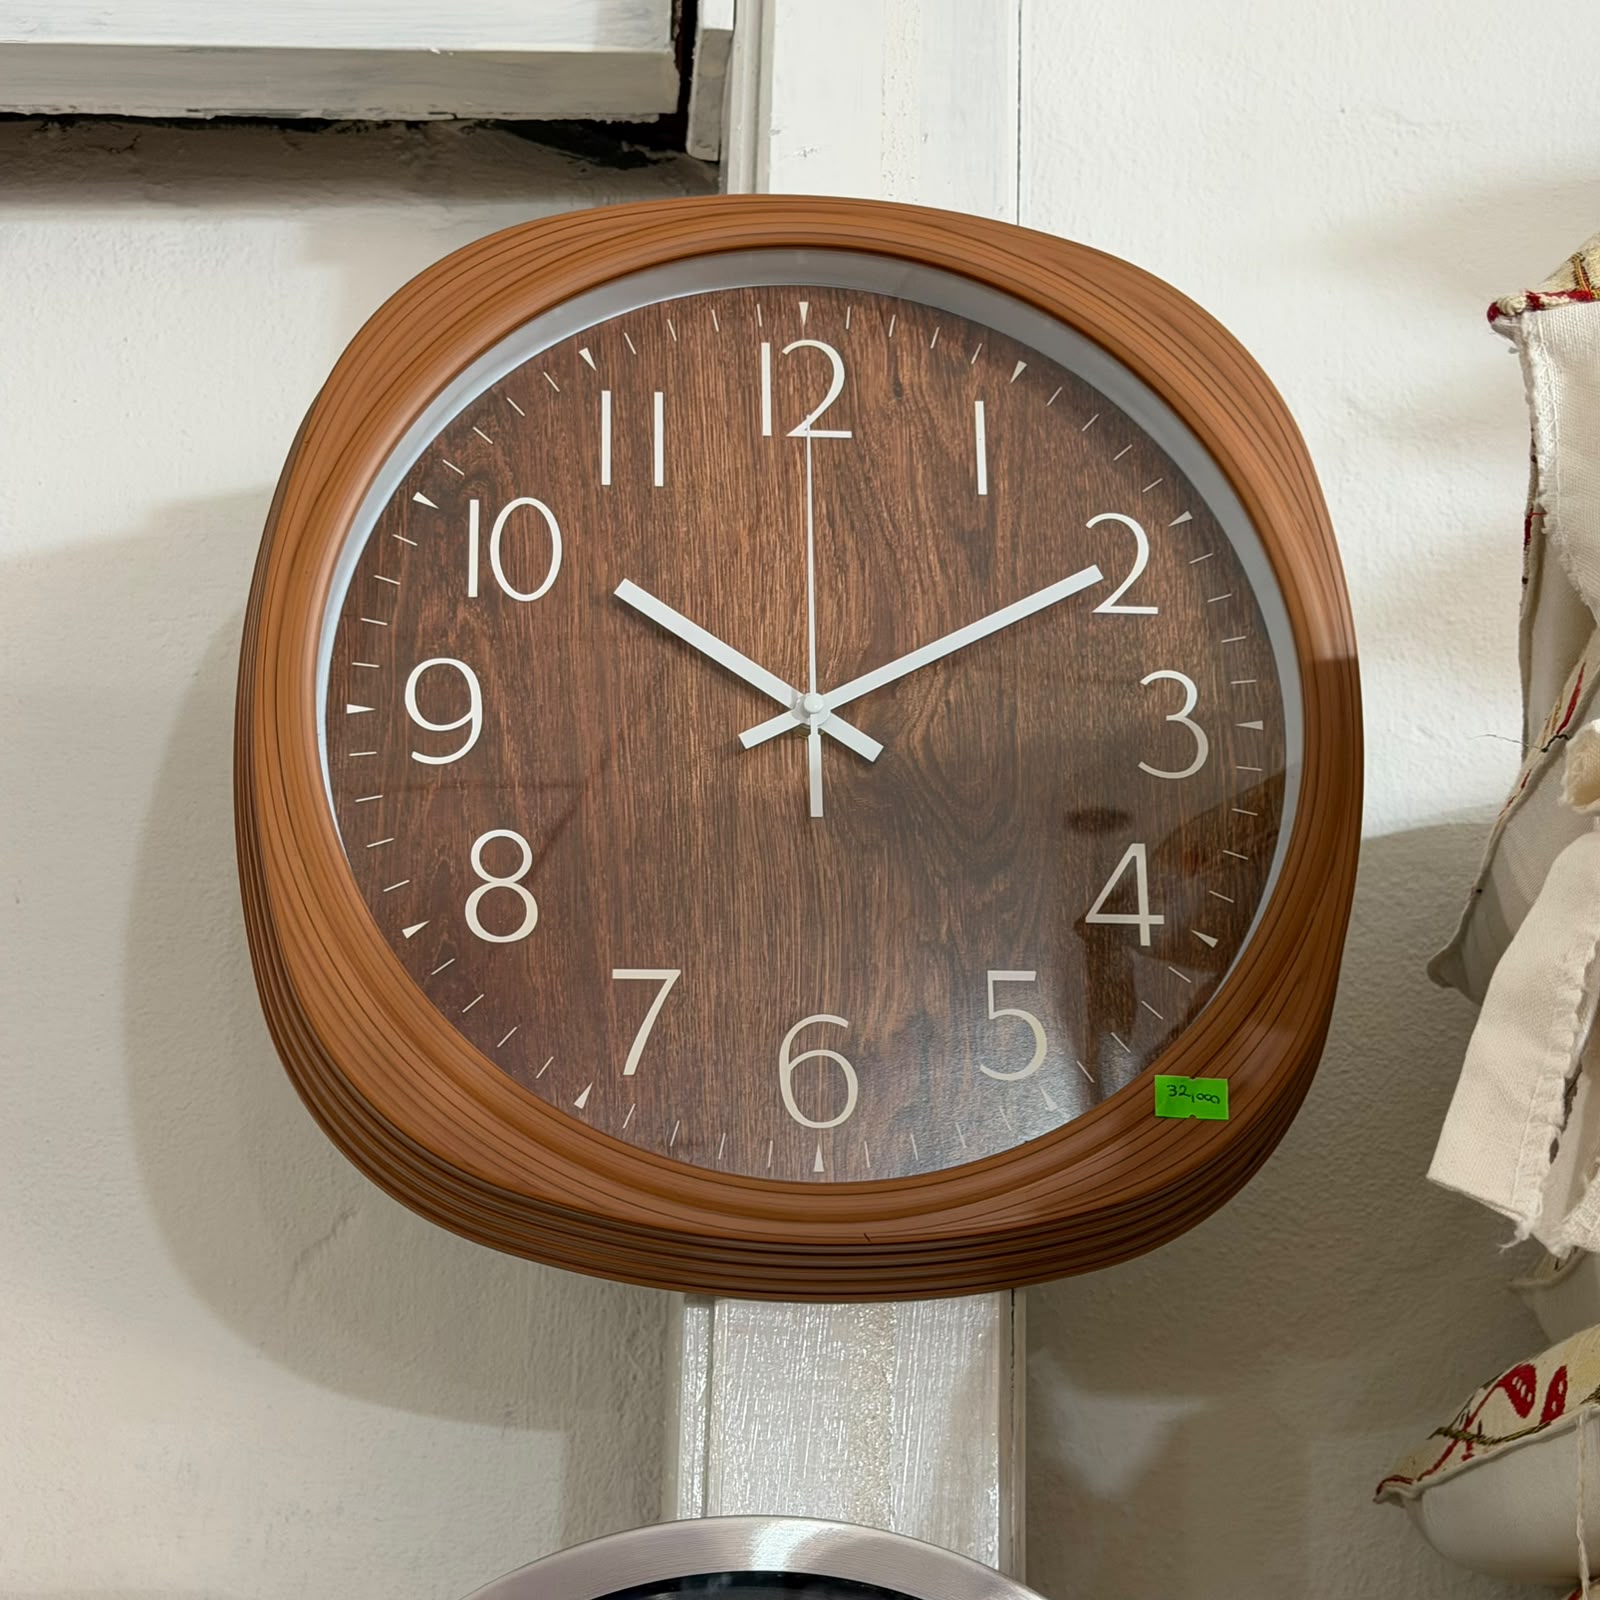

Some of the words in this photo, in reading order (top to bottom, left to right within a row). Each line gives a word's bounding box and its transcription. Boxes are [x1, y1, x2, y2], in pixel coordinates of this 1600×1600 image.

[601, 390, 664, 486] 11
[761, 339, 852, 439] 12
[974, 400, 988, 496] 1
[467, 497, 562, 602] 10
[1085, 512, 1158, 615] 2
[404, 657, 482, 765] 9
[1137, 669, 1208, 779] 3
[464, 829, 538, 943] 8
[1085, 843, 1165, 946] 4
[612, 968, 681, 1076] 7
[778, 1013, 859, 1129] 6
[979, 970, 1048, 1081] 5
[1166, 1084, 1220, 1104] 32,000
